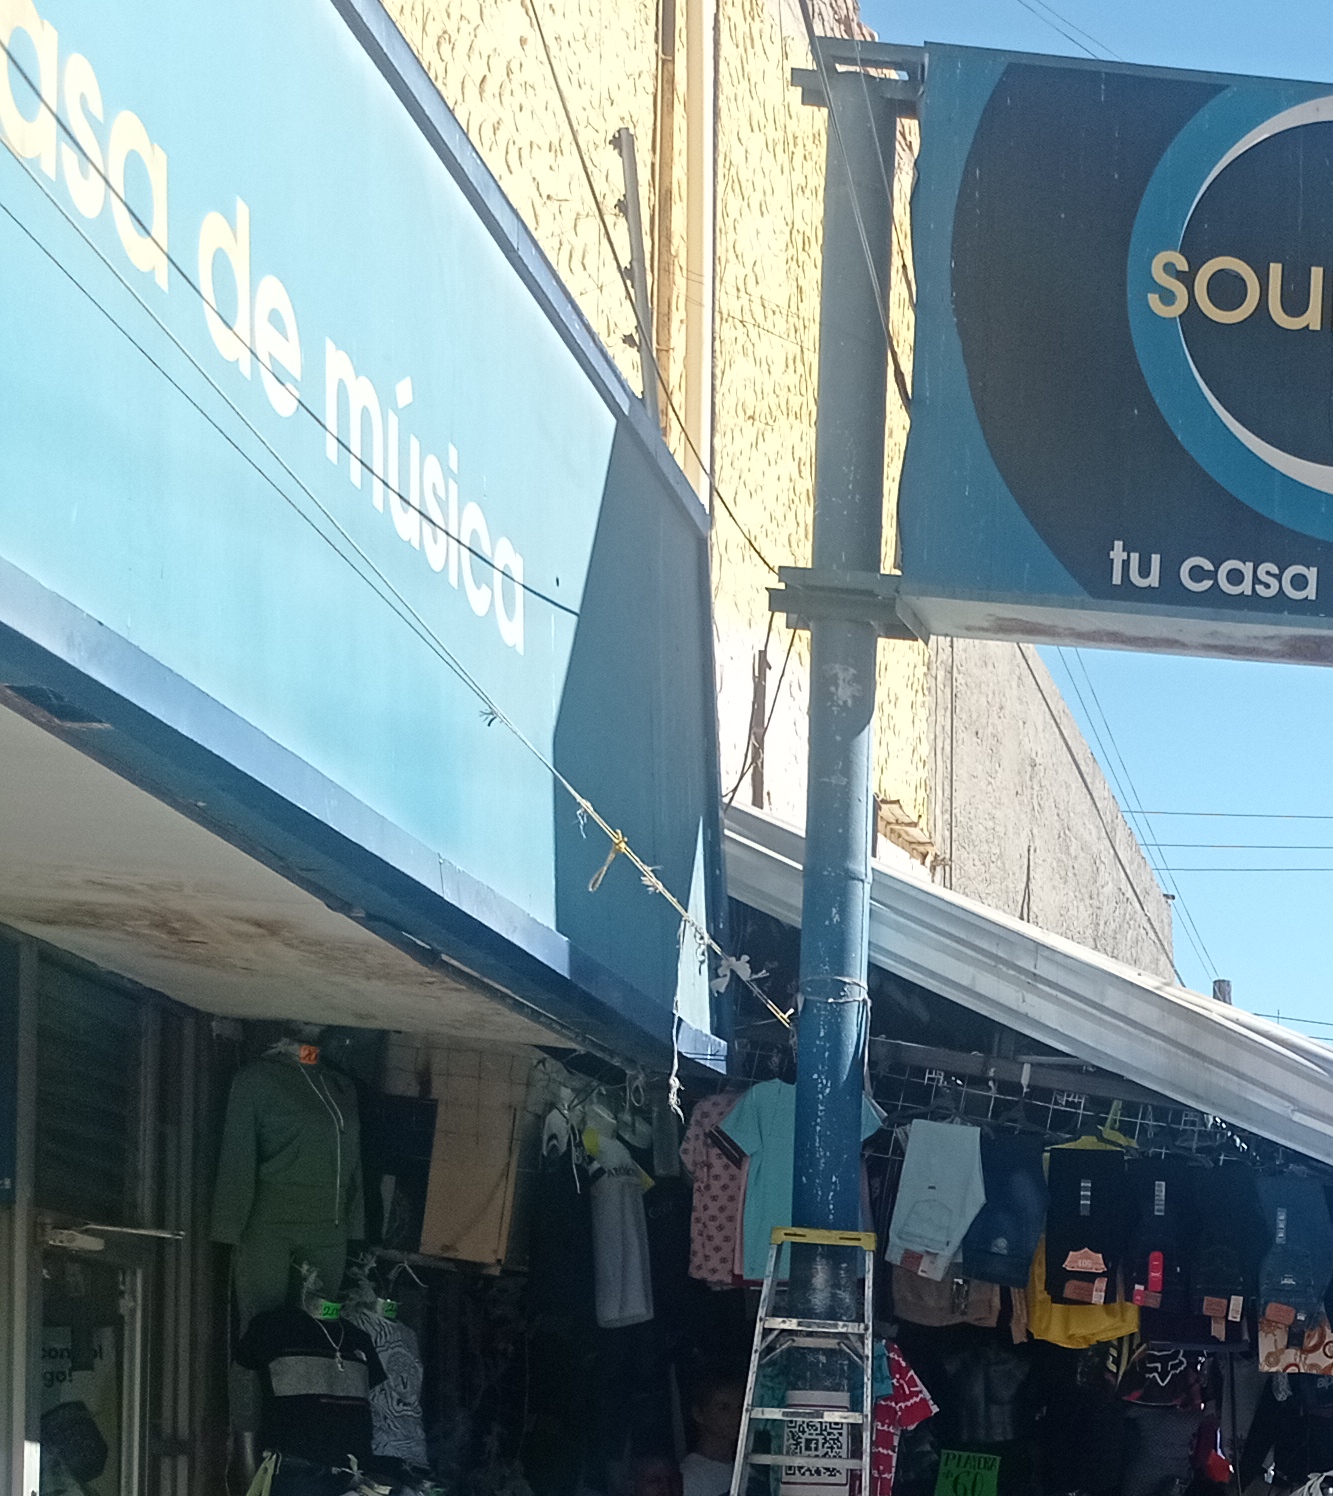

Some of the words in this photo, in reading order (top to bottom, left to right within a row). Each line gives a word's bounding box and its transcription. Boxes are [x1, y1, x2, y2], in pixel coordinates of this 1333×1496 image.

[0, 5, 169, 292] asa
[197, 197, 303, 417] de
[325, 336, 526, 655] música
[1109, 540, 1160, 589] tu
[1180, 556, 1317, 602] casa
